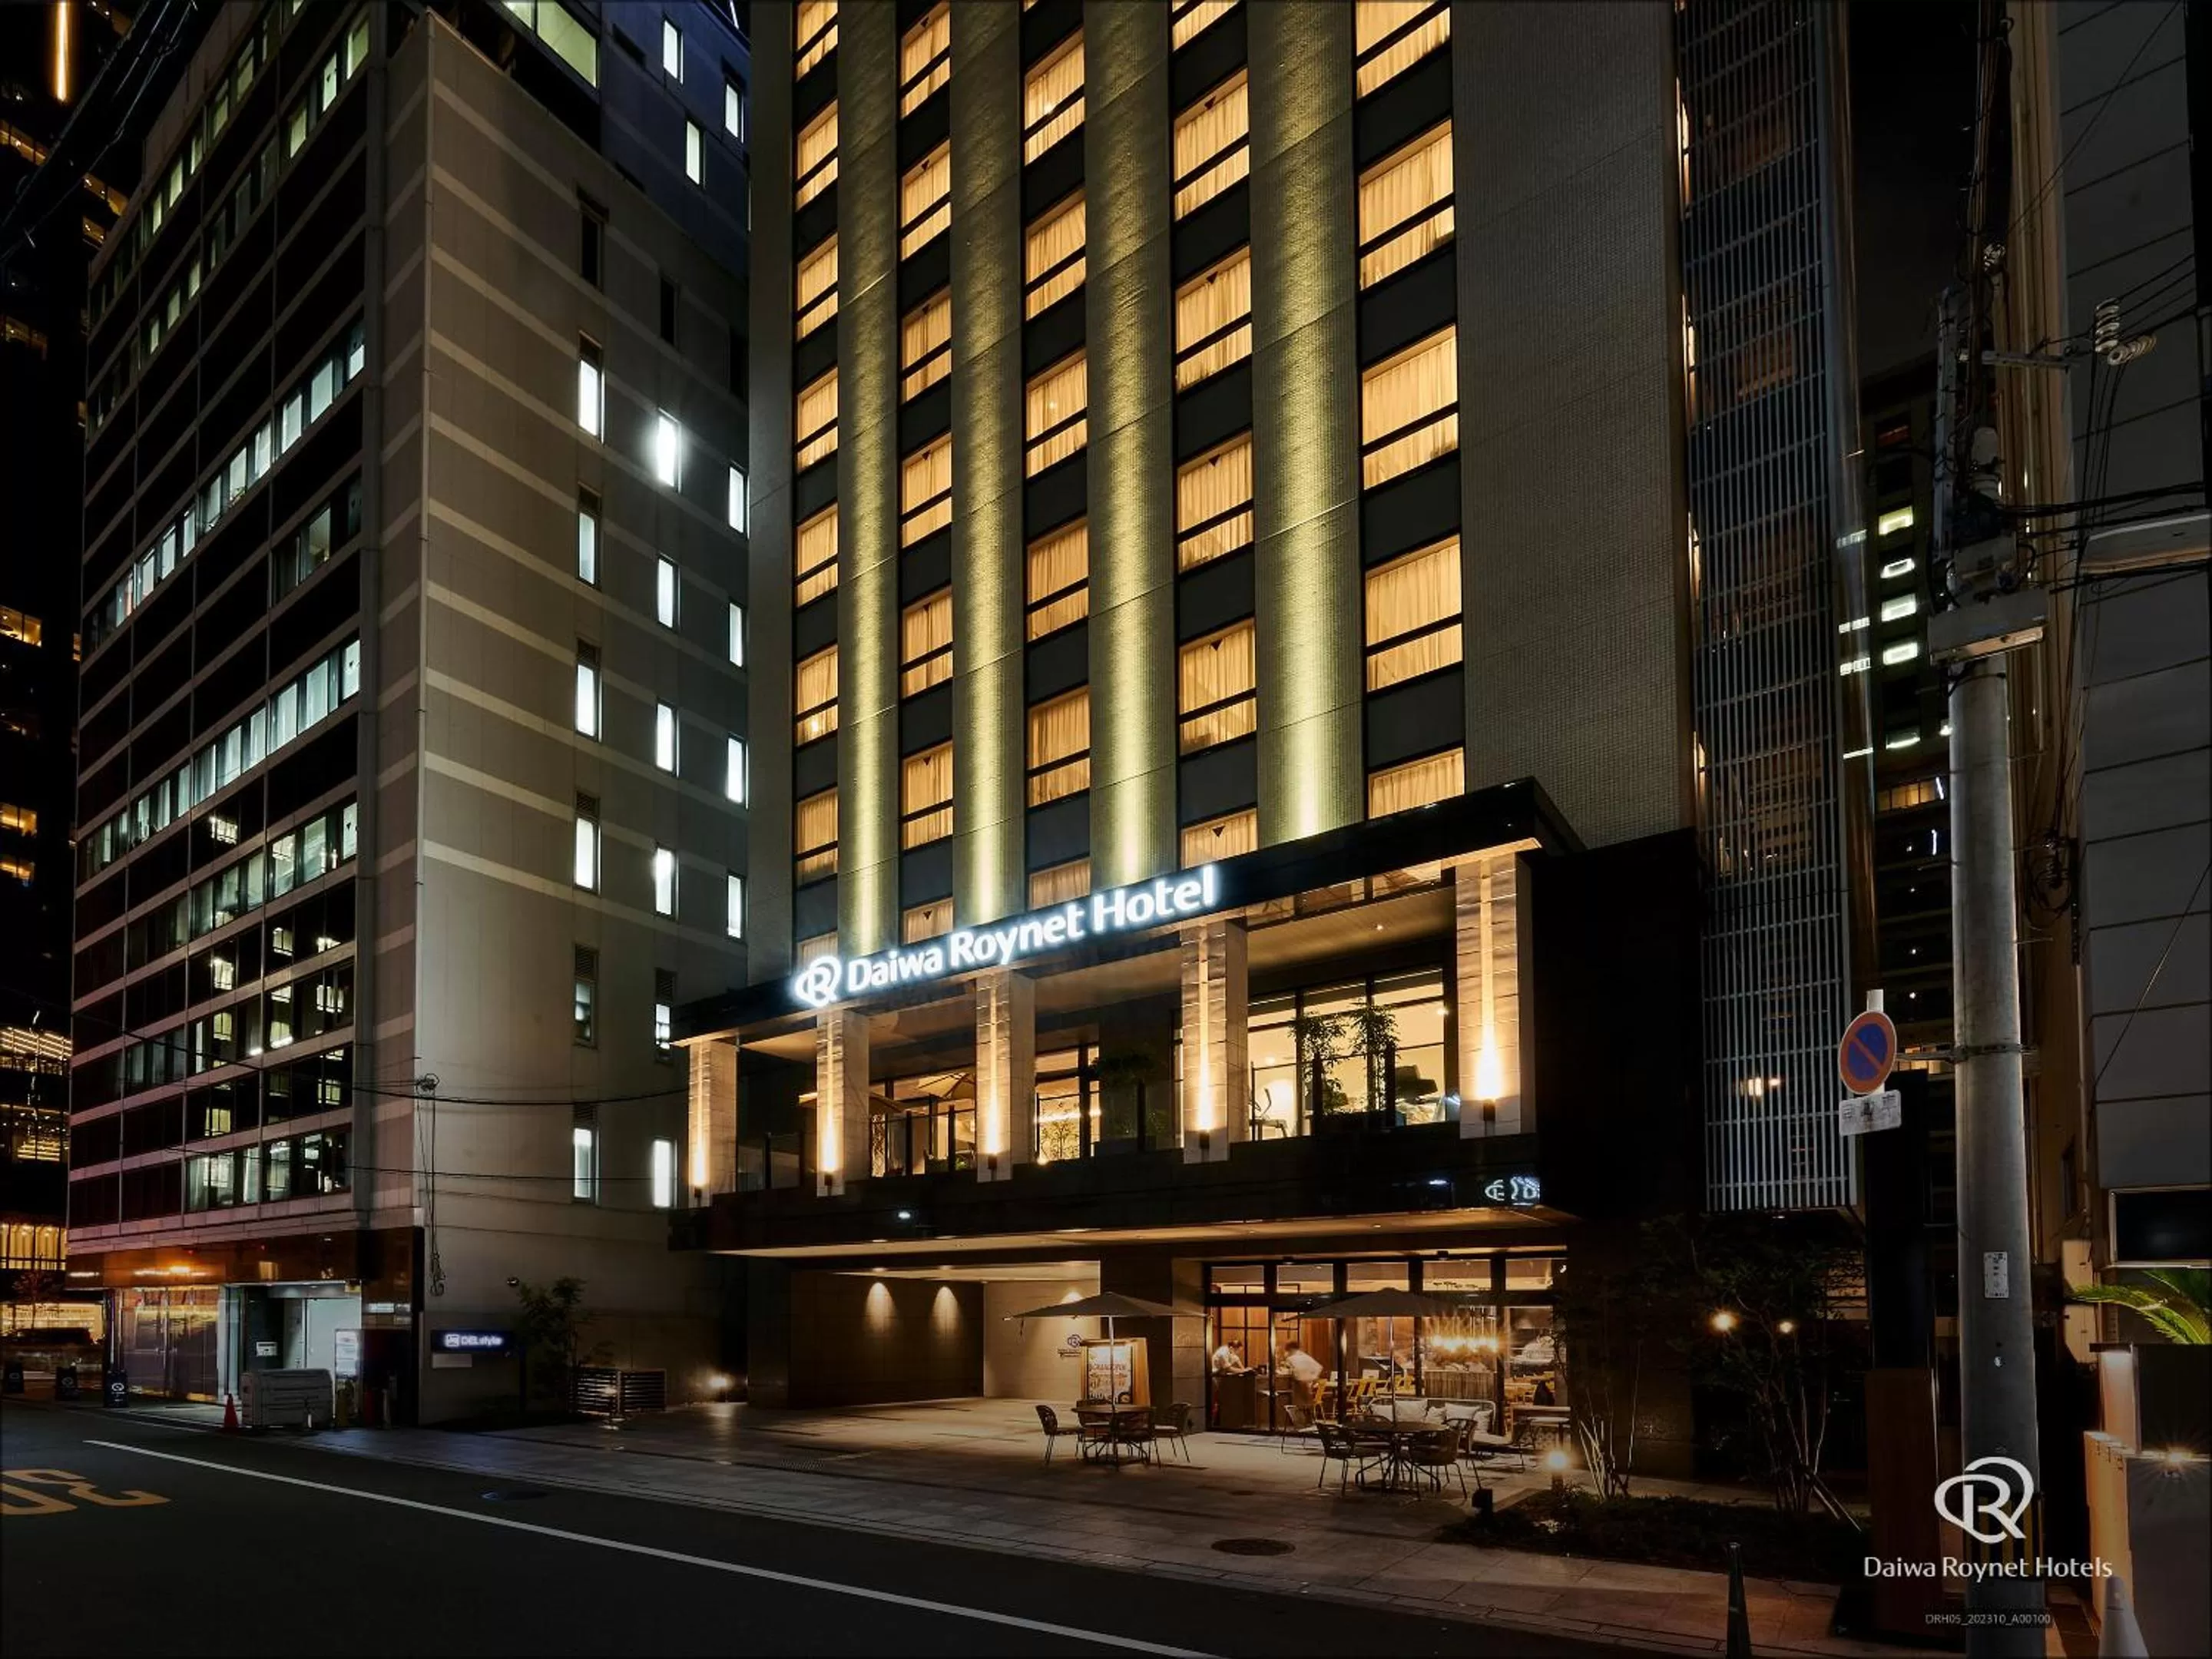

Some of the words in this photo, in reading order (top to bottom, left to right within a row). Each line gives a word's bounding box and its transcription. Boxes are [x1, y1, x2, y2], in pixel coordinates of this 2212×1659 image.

[846, 948, 944, 992] Daiwa
[949, 903, 1085, 965] Roynet
[1092, 864, 1216, 932] Hotel
